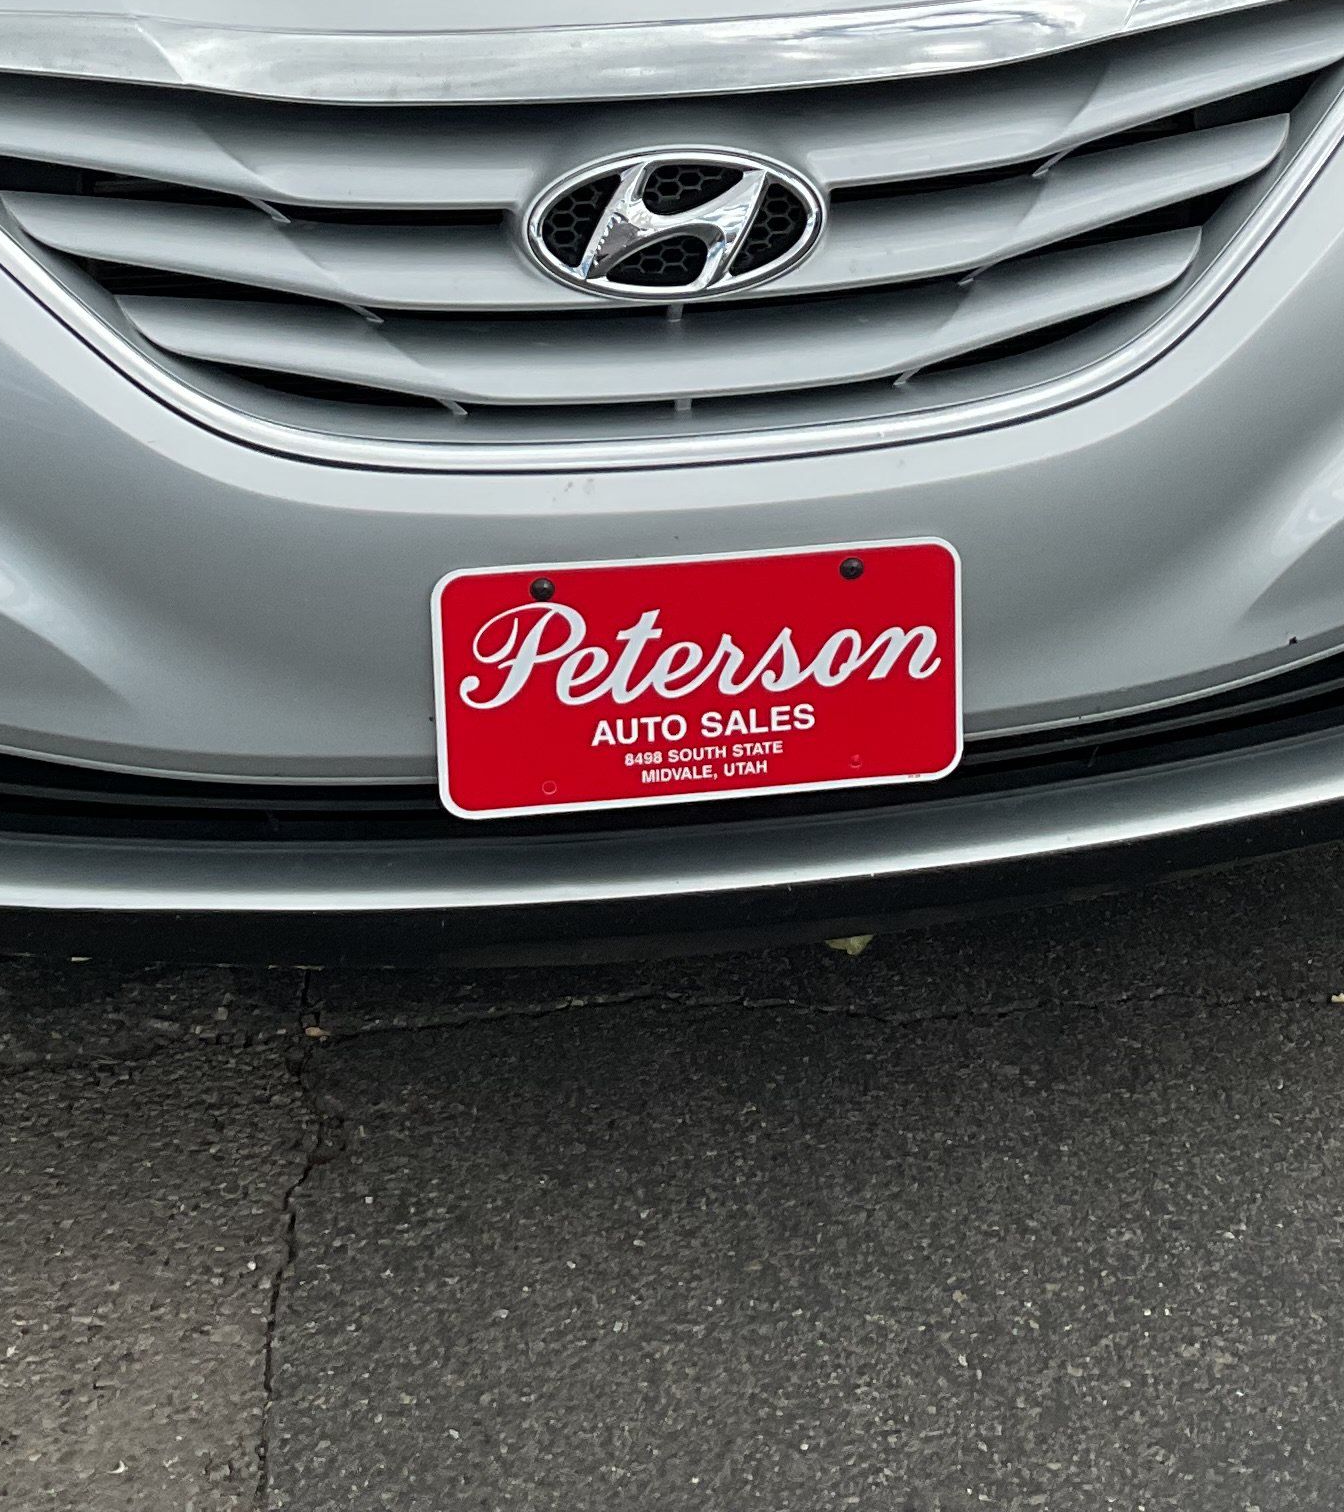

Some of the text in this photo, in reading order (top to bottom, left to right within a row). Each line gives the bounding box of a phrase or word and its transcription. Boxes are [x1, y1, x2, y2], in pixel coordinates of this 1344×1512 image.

[459, 601, 943, 709] Peterson
[591, 703, 816, 746] AUTO SALES
[624, 740, 783, 766] 8498 SOUTH STATE
[641, 759, 768, 784] MIDVALE, UTAH
